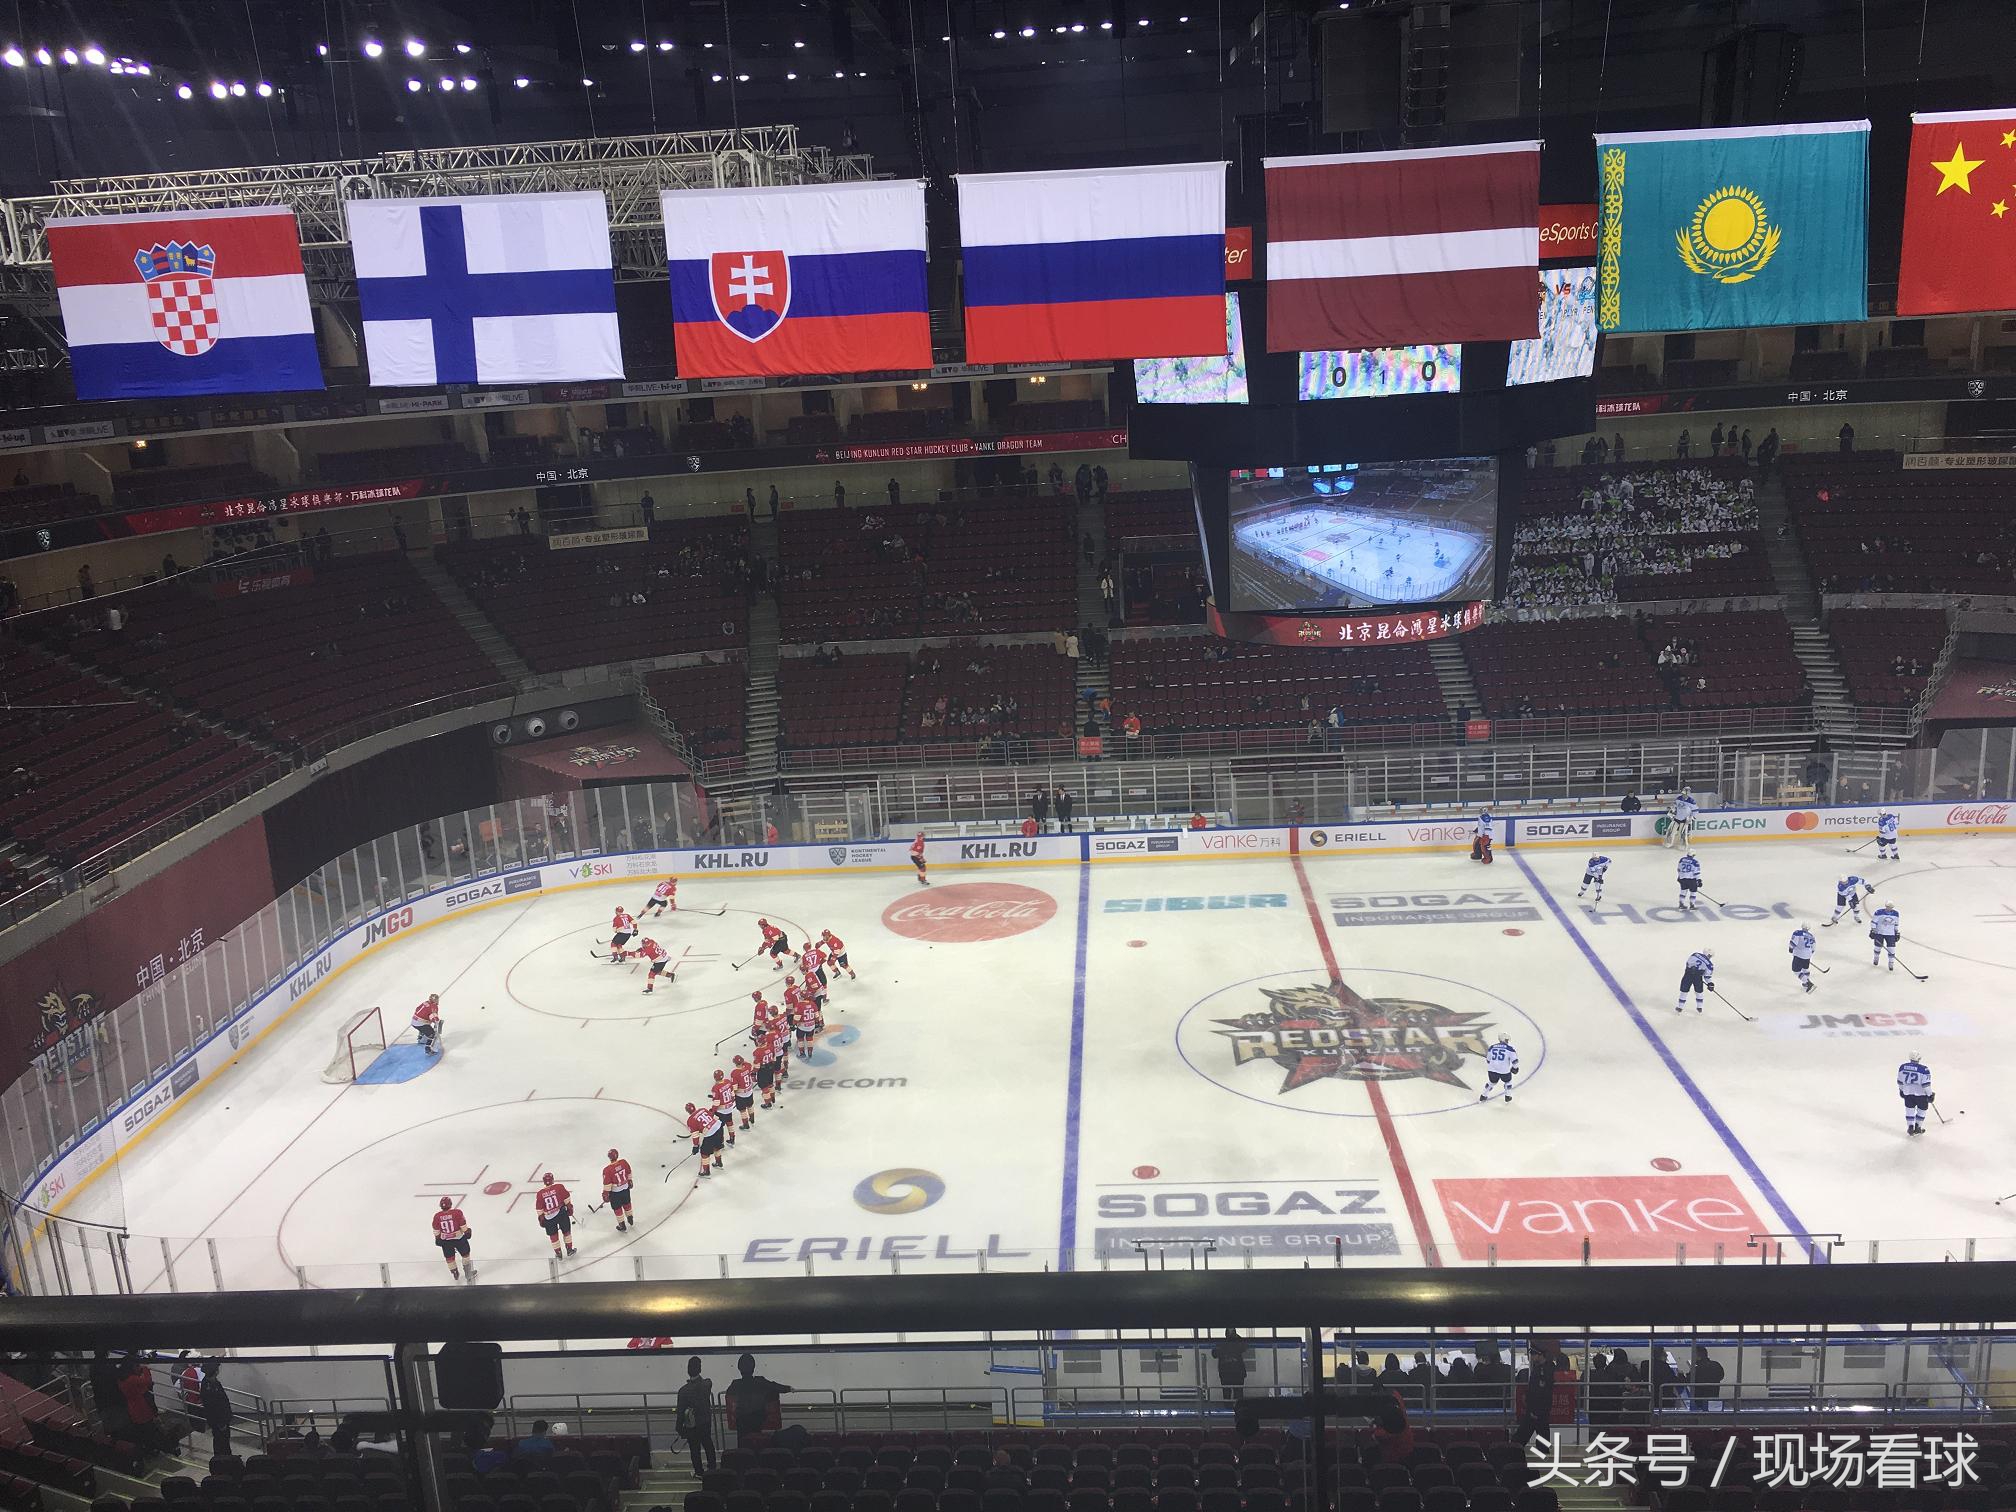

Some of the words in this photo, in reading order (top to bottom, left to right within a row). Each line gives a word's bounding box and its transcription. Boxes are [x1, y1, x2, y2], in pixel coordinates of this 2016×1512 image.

[1540, 222, 1590, 245] eSports
[1555, 282, 1571, 295] VS
[1332, 366, 1346, 387] 0
[1379, 369, 1386, 385] 1
[1422, 360, 1436, 381] 0
[835, 449, 862, 460] BEIJING
[864, 448, 890, 458] KUNLUN
[891, 447, 904, 456] RED
[906, 446, 923, 455] STAR
[924, 445, 949, 454] HOCKEY
[951, 443, 969, 453] CLUB
[974, 441, 995, 452] VANKE
[997, 440, 1023, 451] DRAGON
[1025, 439, 1043, 449] TEAM
[1335, 832, 1387, 843] ERIELL
[1407, 826, 1465, 842] vanke
[1526, 823, 1589, 836] SOGAZ
[960, 841, 1038, 859] KHL.RU
[1096, 840, 1146, 851] SOGAZ
[1201, 833, 1258, 849] vanke
[694, 851, 769, 869] KHL.RU
[446, 882, 503, 908] SOGAZ
[1103, 893, 1289, 913] SIBUR
[1329, 892, 1530, 909] SOGAZ
[1343, 912, 1456, 924] INSURANCE
[1462, 909, 1530, 919] GROUP
[1578, 901, 1796, 925] Haier
[361, 906, 414, 949] JMGO
[289, 952, 332, 1001] KHL.RU
[1800, 1012, 1928, 1029] JMGO
[1210, 1022, 1497, 1066] REDSTAR
[1491, 1048, 1506, 1061] 55
[781, 1076, 908, 1090] elecom
[1902, 1071, 1919, 1084] 72
[124, 1085, 172, 1132] SOGAZ
[1097, 1189, 1386, 1218] SOGAZ
[1453, 1197, 1750, 1235] vanke
[439, 1219, 455, 1234] 91
[742, 1233, 1032, 1263] ERIELL
[1284, 1234, 1384, 1246] GROUP
